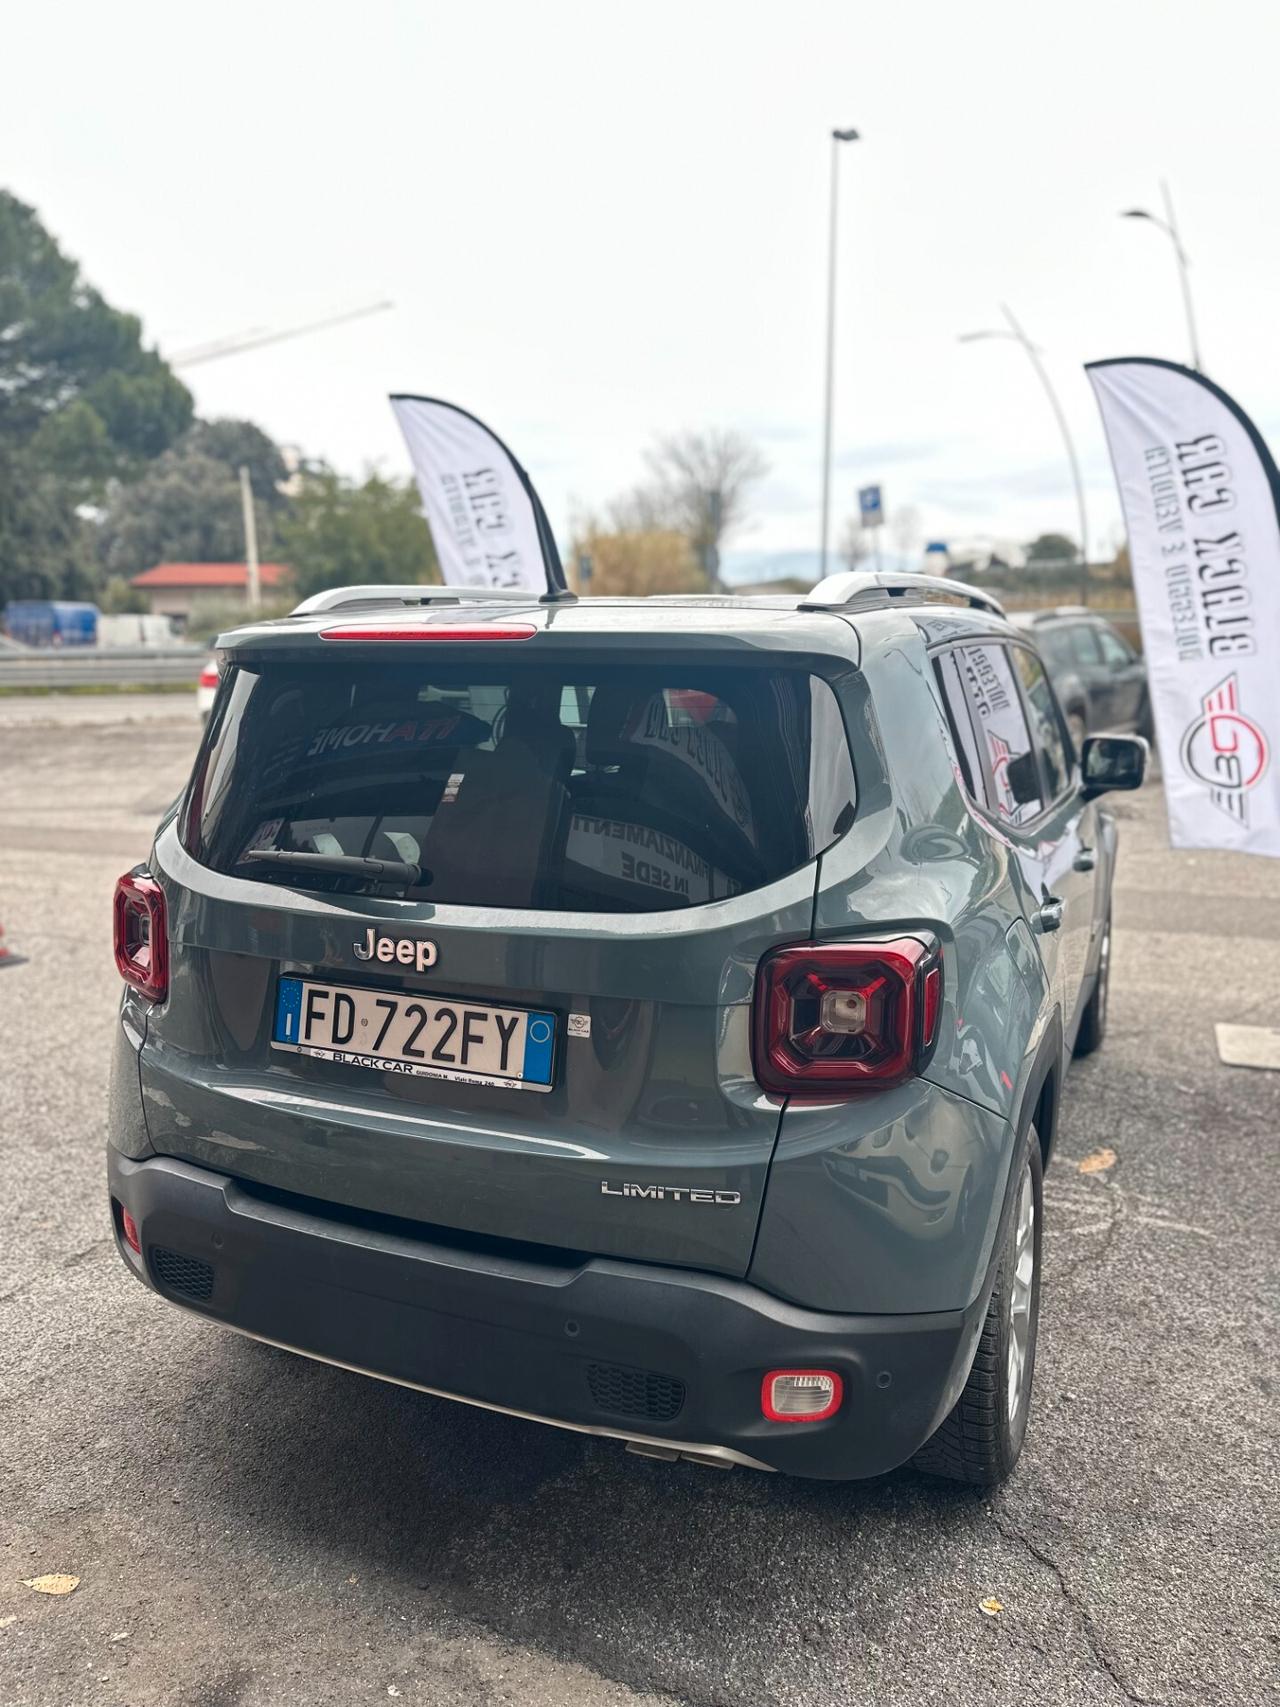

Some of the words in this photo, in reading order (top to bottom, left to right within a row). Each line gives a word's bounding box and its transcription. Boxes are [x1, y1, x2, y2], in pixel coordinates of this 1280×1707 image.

[353, 928, 438, 972] Jeep
[305, 989, 356, 1045] FD
[372, 998, 520, 1071] 722FY
[333, 1052, 380, 1069] BLACK
[382, 1060, 413, 1074] CAR
[601, 1180, 742, 1204] LIMITED
